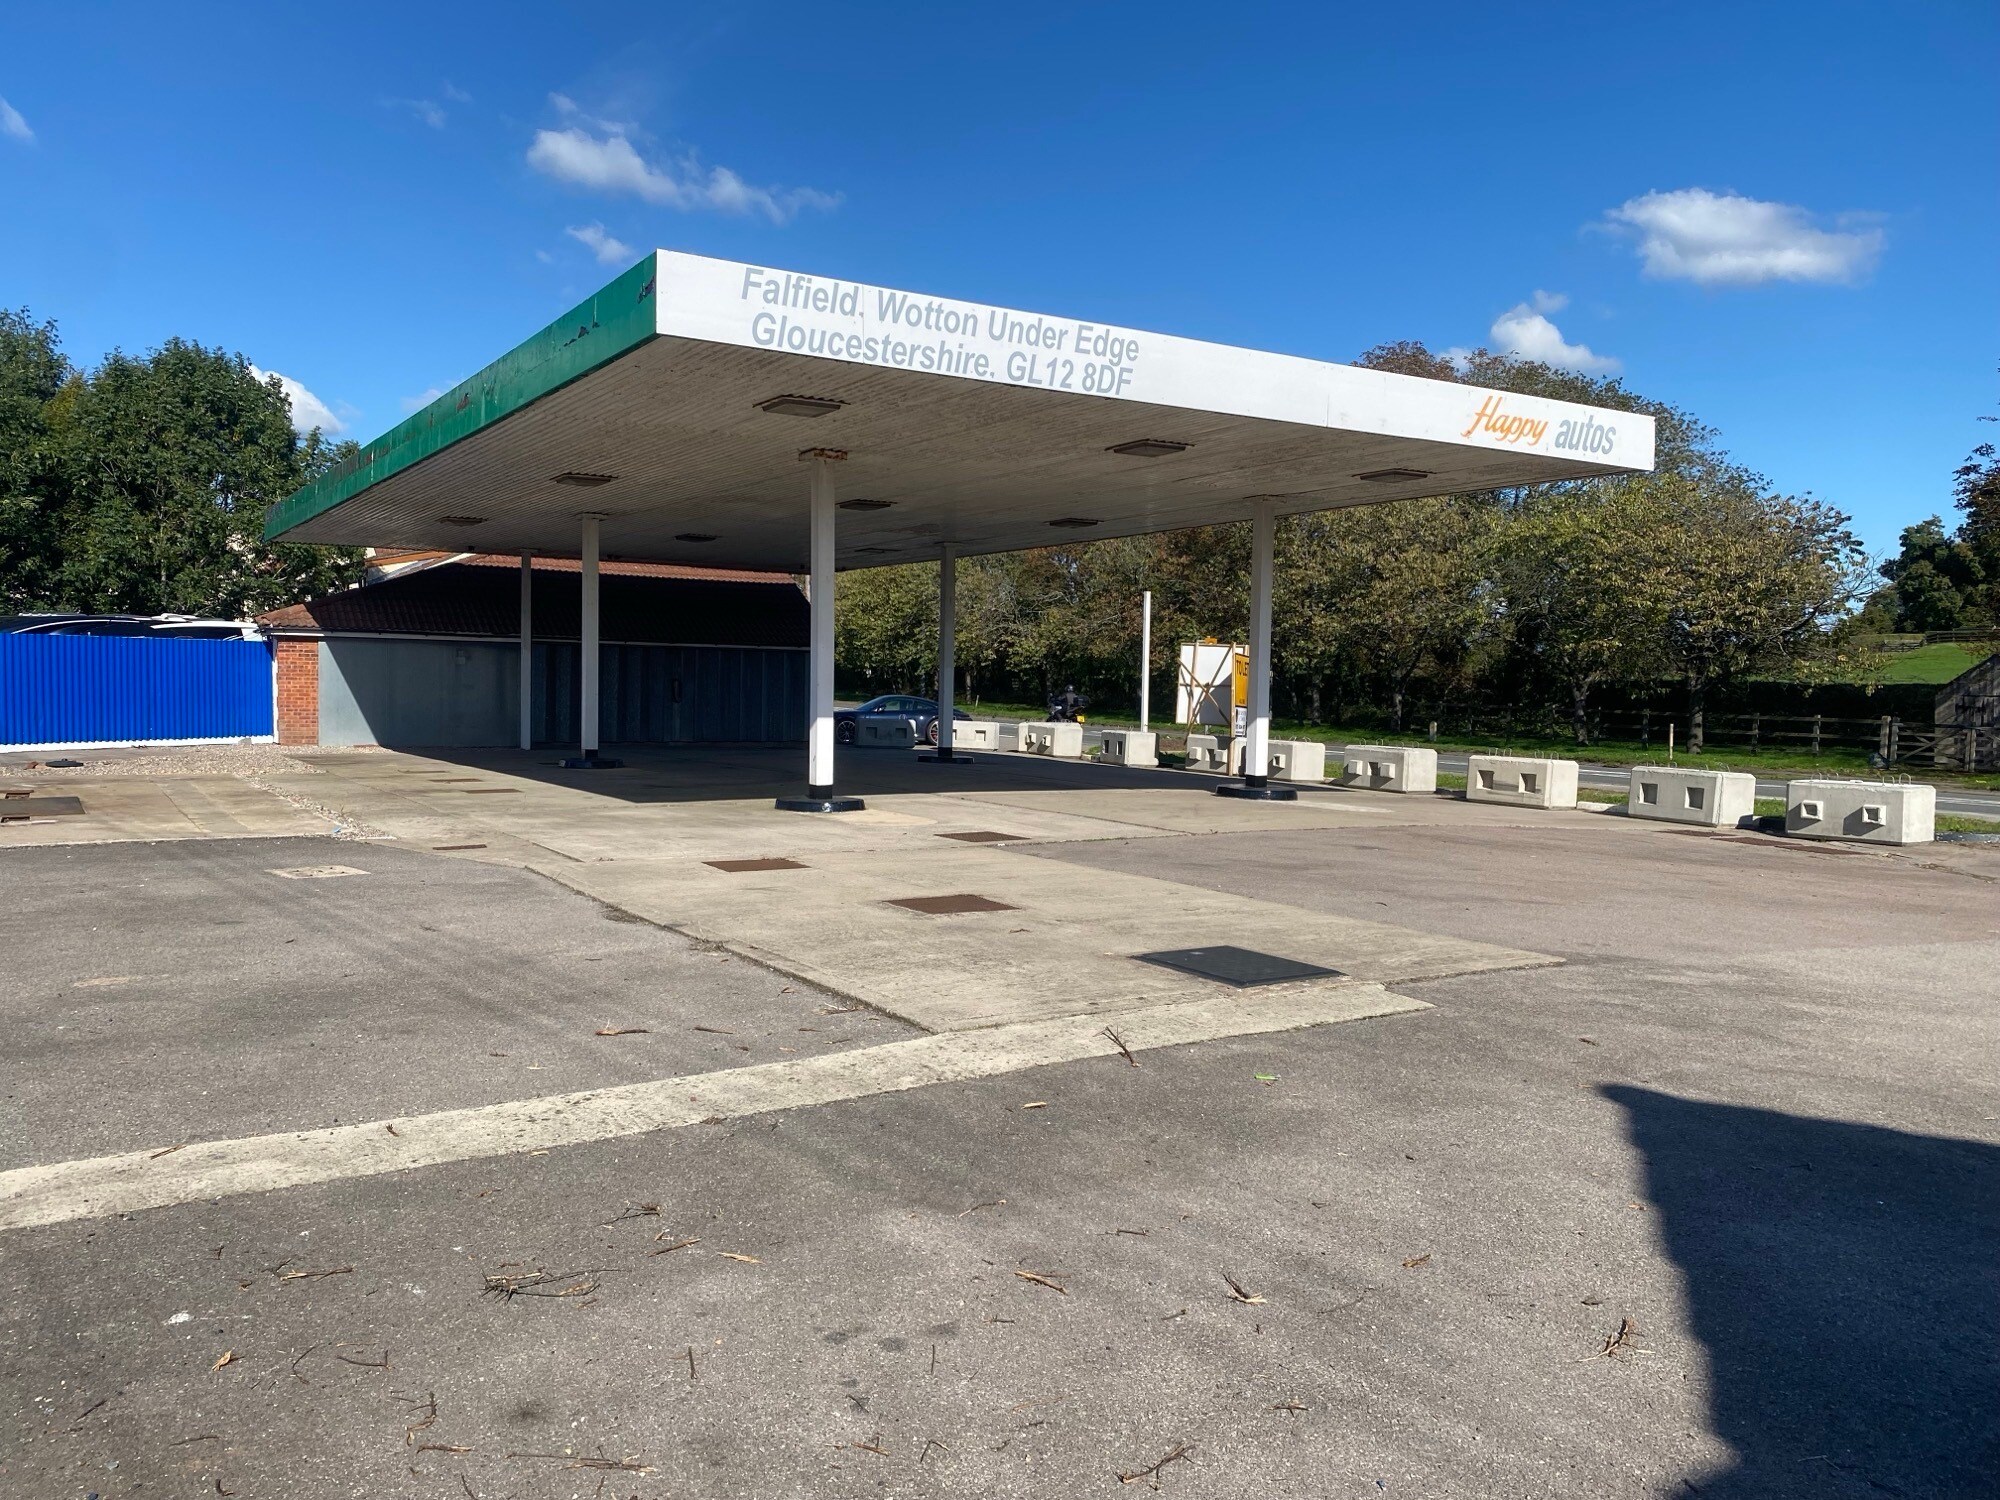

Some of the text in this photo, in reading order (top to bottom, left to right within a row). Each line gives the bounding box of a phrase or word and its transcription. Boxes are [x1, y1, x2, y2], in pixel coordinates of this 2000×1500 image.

[877, 289, 978, 337] Wotton
[988, 310, 1069, 350] Under
[1074, 323, 1139, 367] Edge
[1006, 351, 1074, 389] GL12
[1081, 362, 1134, 396] 8DF
[1460, 395, 1616, 455] Happy autos
